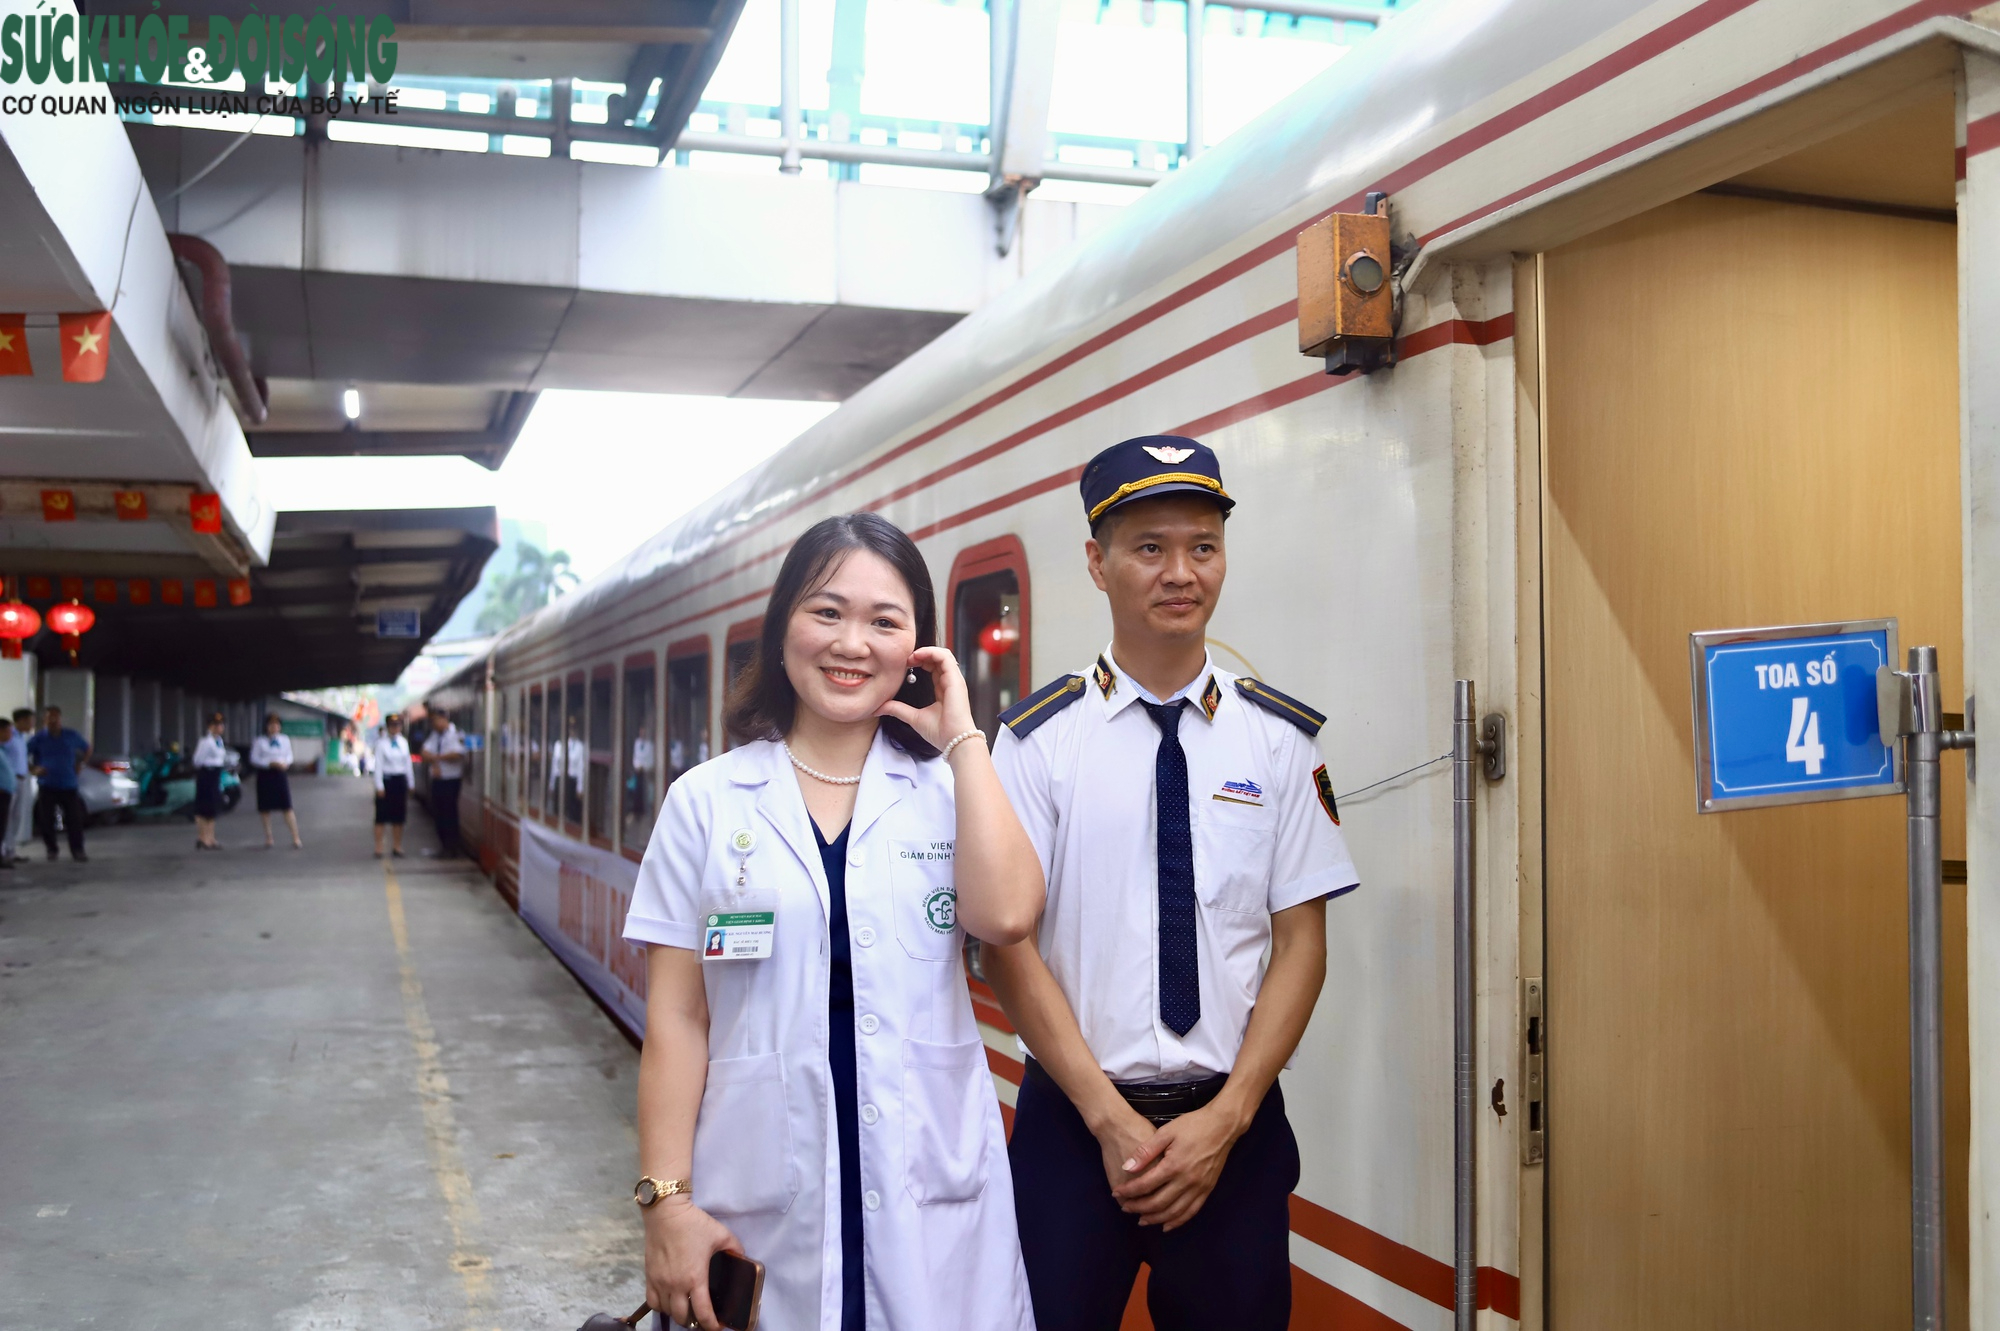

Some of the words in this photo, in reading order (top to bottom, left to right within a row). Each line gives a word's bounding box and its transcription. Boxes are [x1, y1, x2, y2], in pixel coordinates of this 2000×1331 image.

[1755, 663, 1799, 690] TOA
[1806, 651, 1837, 686] SỐ
[1786, 697, 1825, 775] 4
[900, 850, 925, 860] GIÁM
[927, 852, 951, 861] ĐỊNH
